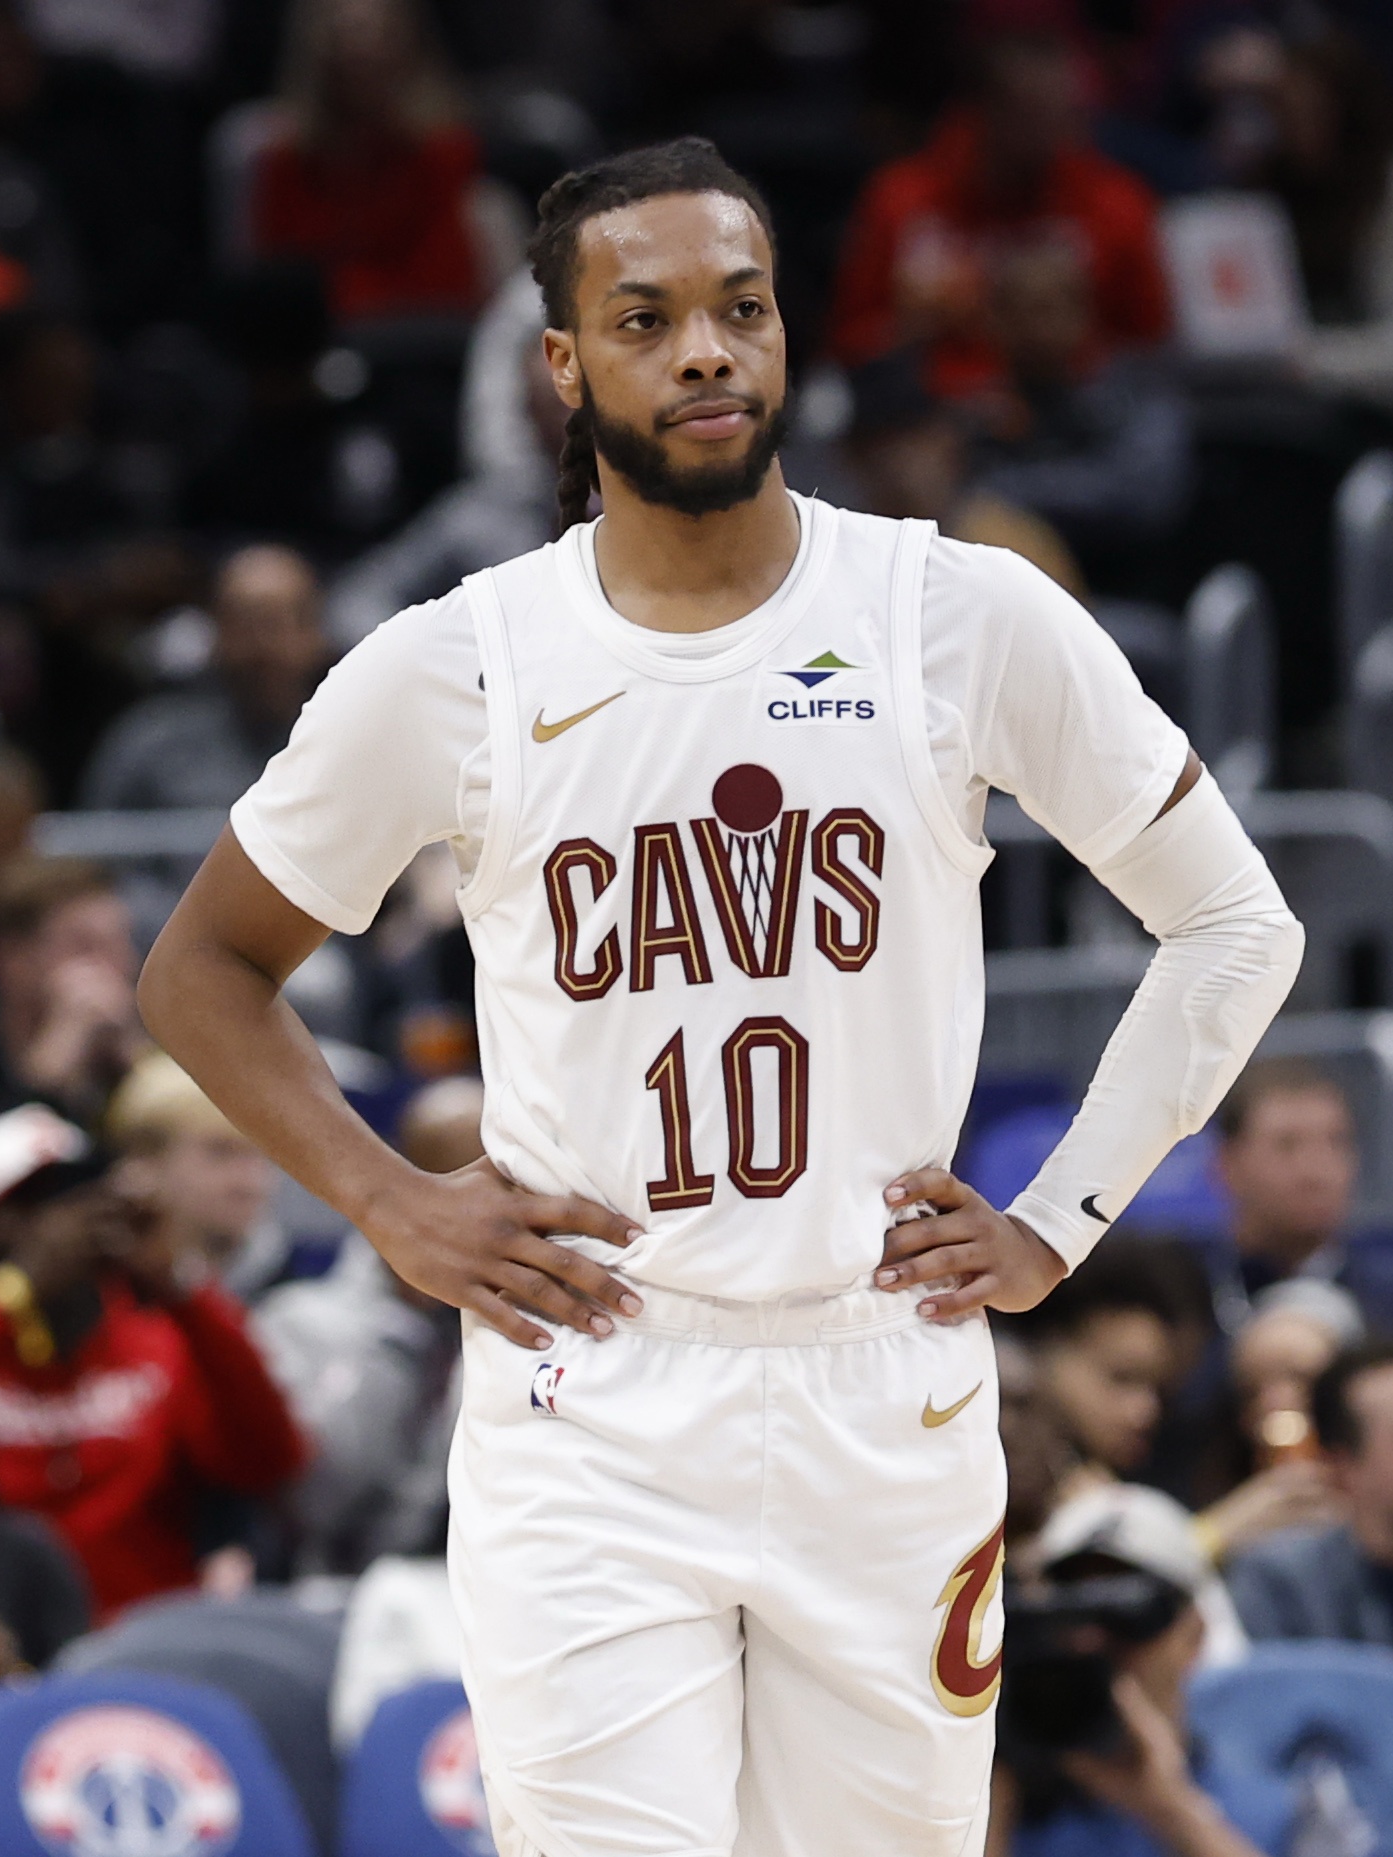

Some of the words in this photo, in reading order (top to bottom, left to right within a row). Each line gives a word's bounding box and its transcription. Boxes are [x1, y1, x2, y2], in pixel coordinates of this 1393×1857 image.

[767, 699, 875, 720] CLIFFS
[543, 807, 886, 1003] CAVS
[645, 1015, 810, 1213] 10
